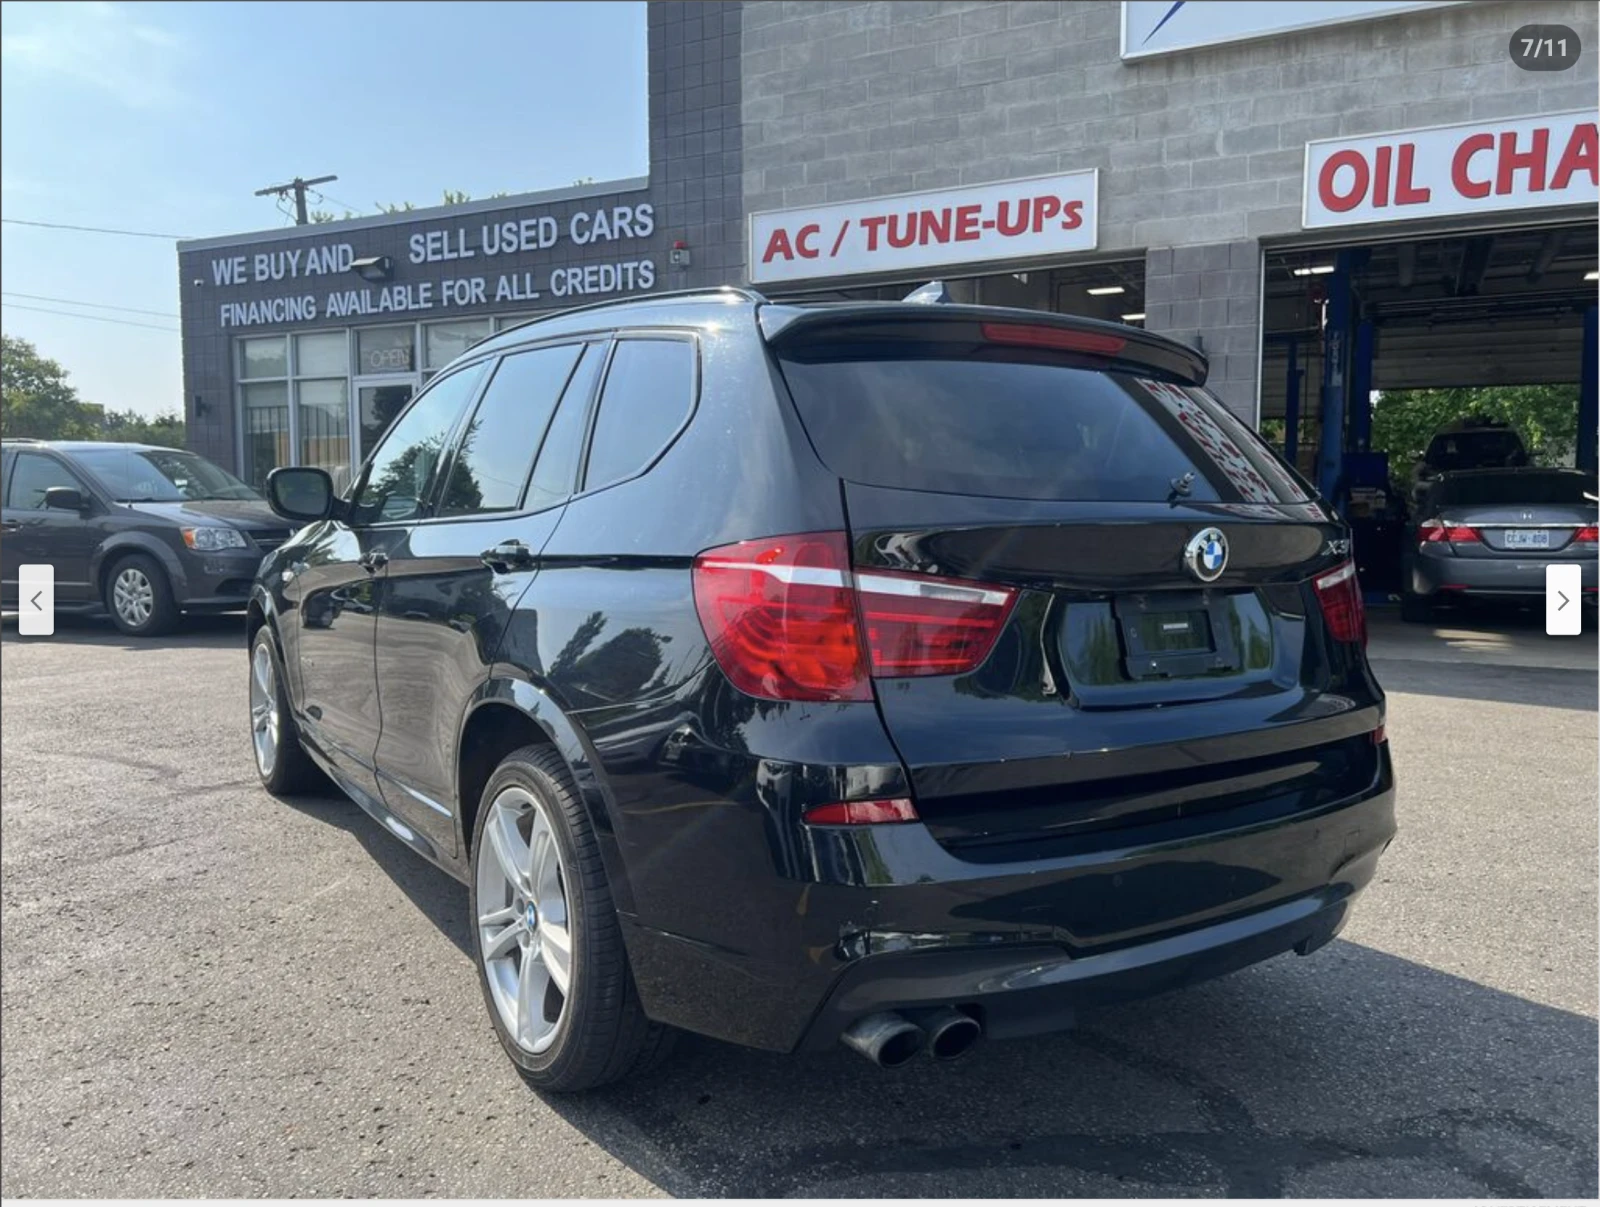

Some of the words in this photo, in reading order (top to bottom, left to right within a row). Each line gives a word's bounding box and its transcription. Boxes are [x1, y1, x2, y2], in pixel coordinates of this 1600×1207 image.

[1318, 142, 1431, 213] OIL
[1451, 122, 1599, 199] CHA
[212, 256, 248, 286] WE
[254, 249, 302, 281] BUY
[304, 243, 354, 277] AND
[409, 228, 475, 264] SELL
[482, 216, 559, 256] USED
[570, 203, 655, 246] CARS
[762, 224, 820, 263] AC
[830, 220, 850, 257] /
[860, 195, 1084, 251] TUNE-UPs
[220, 295, 317, 327] FINANCING
[325, 282, 433, 318] AVAILABLE
[442, 277, 487, 307] FOR
[495, 272, 540, 302] ALL
[550, 260, 655, 297] CREDITS
